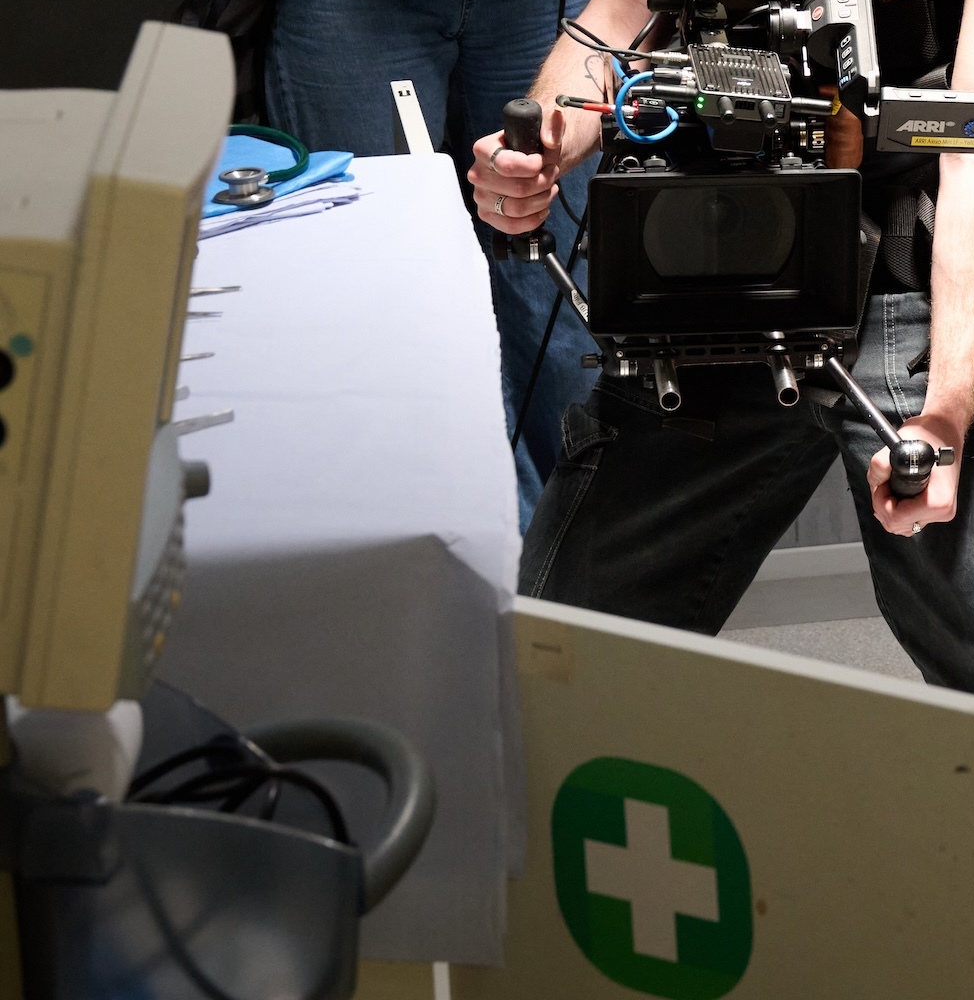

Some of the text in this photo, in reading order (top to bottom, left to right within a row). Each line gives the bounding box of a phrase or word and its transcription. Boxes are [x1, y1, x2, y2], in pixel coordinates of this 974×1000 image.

[896, 119, 945, 134] ARRI
[915, 137, 927, 145] ARRI
[927, 138, 942, 146] Alexa
